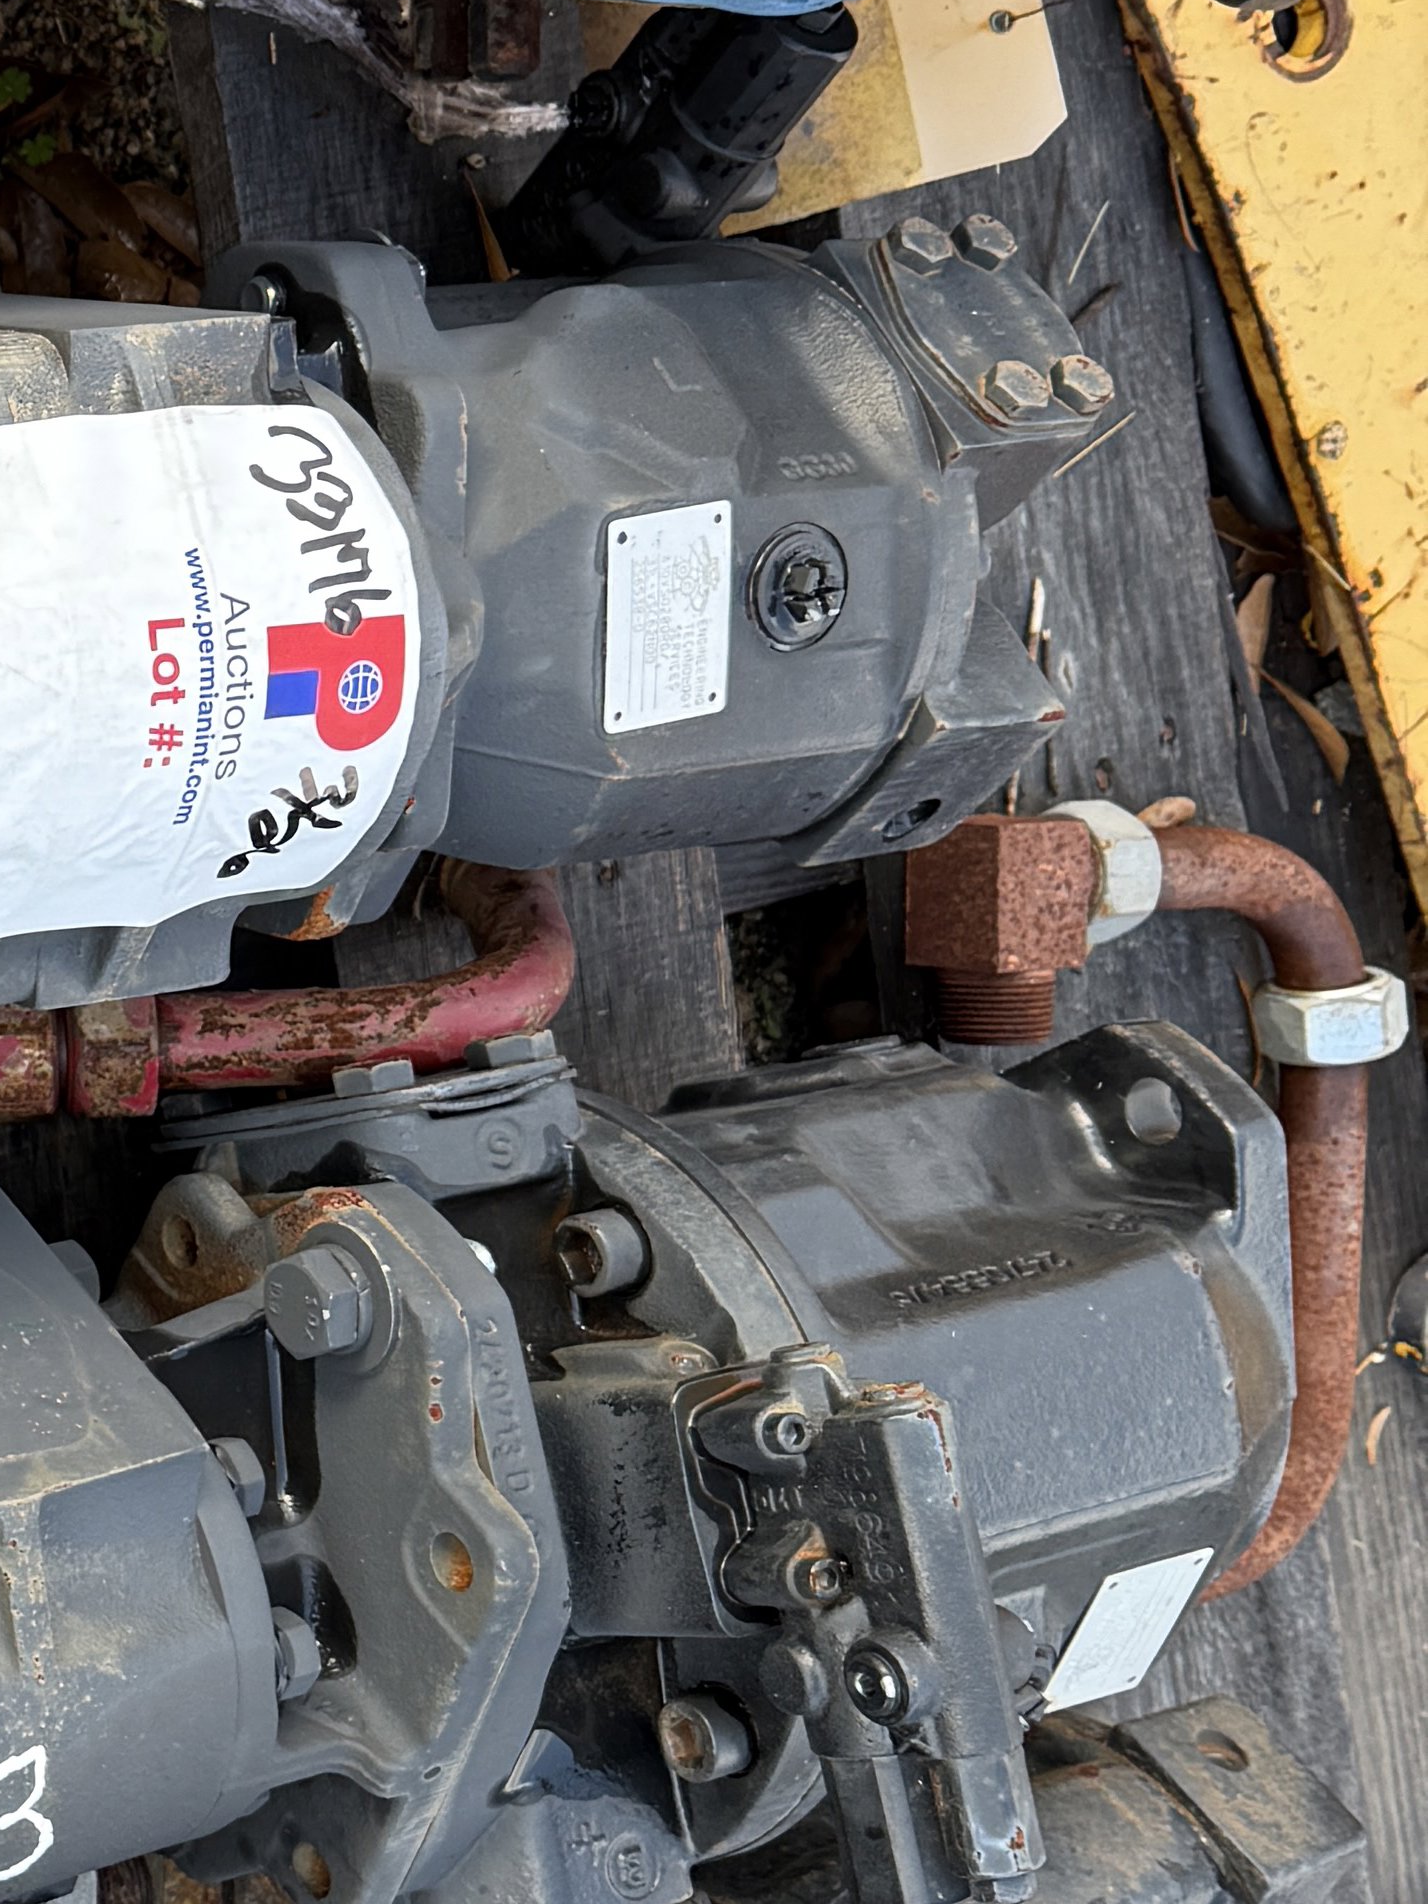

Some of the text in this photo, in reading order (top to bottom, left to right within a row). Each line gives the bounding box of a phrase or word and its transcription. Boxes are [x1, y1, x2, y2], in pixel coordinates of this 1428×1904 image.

[141, 618, 185, 770] Lot #:
[171, 548, 209, 824] www.permianint.com
[213, 592, 251, 782] Auctions
